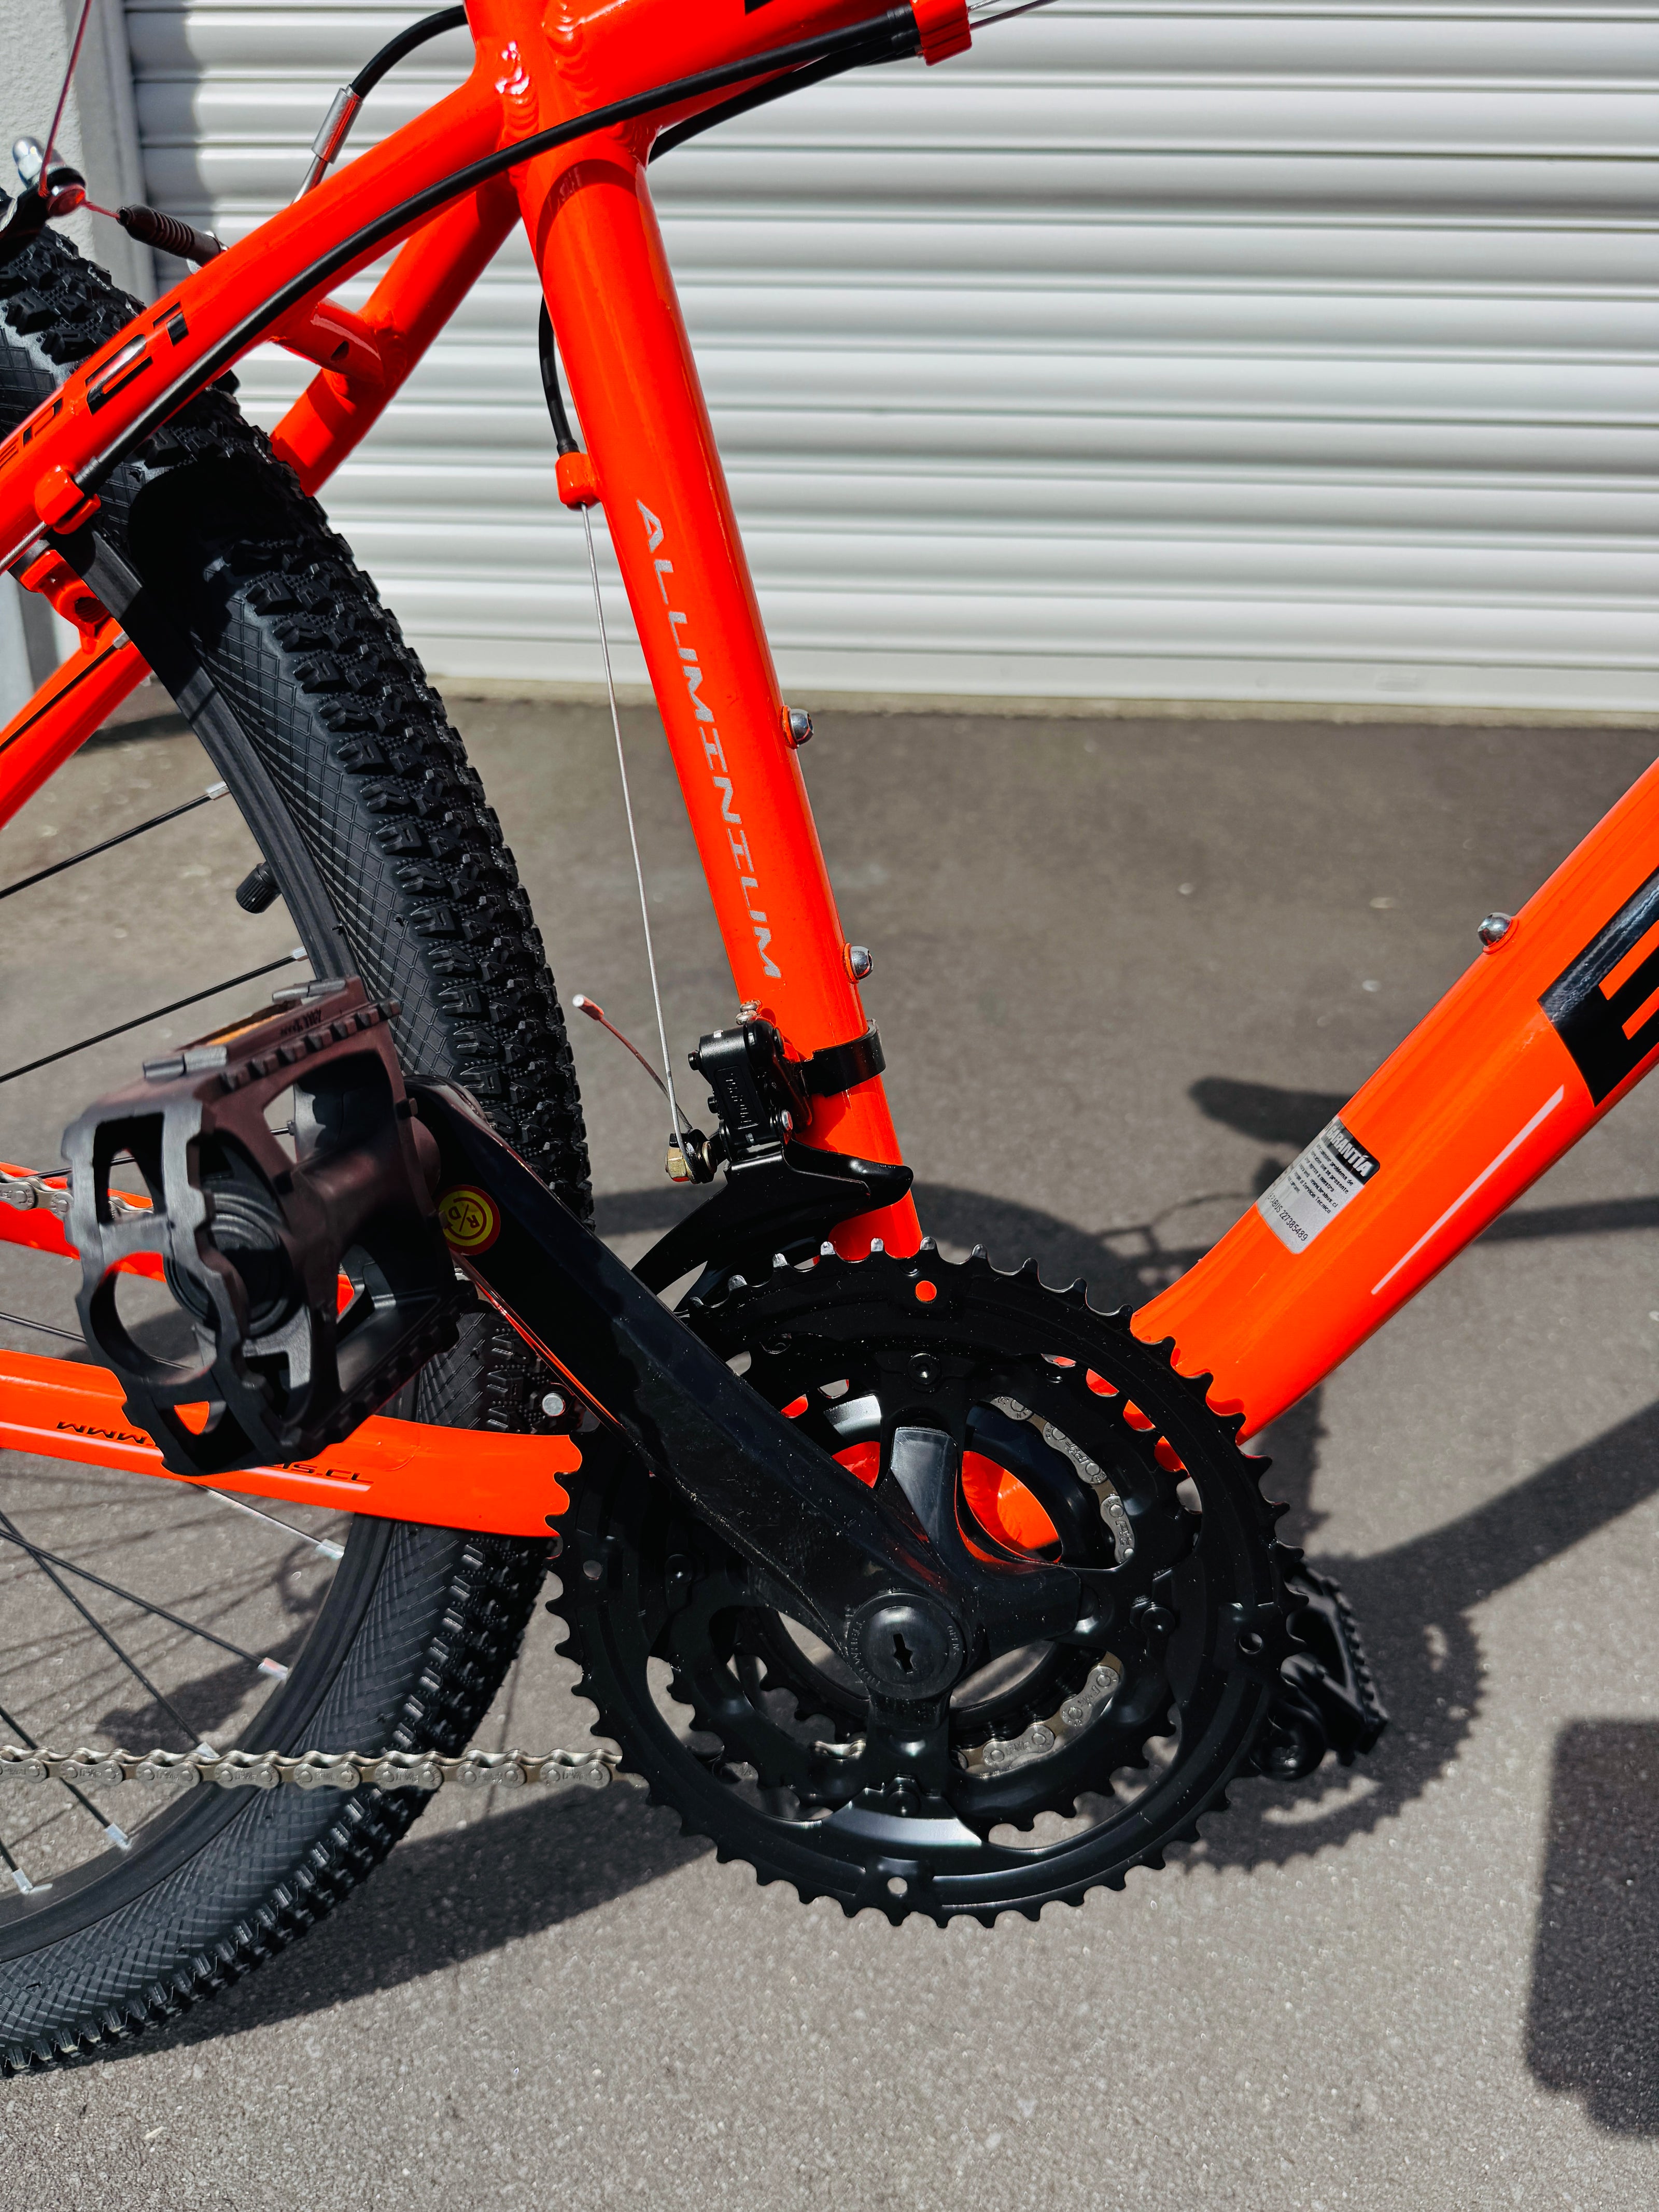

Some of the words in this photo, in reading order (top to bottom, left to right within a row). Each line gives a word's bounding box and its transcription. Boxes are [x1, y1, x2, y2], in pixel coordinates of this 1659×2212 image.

[1326, 1124, 1373, 1177] GARANTÍA
[1329, 1161, 1348, 1180] problema
[1329, 1174, 1349, 1195] presente
[1279, 1210, 1308, 1241] 227385489
